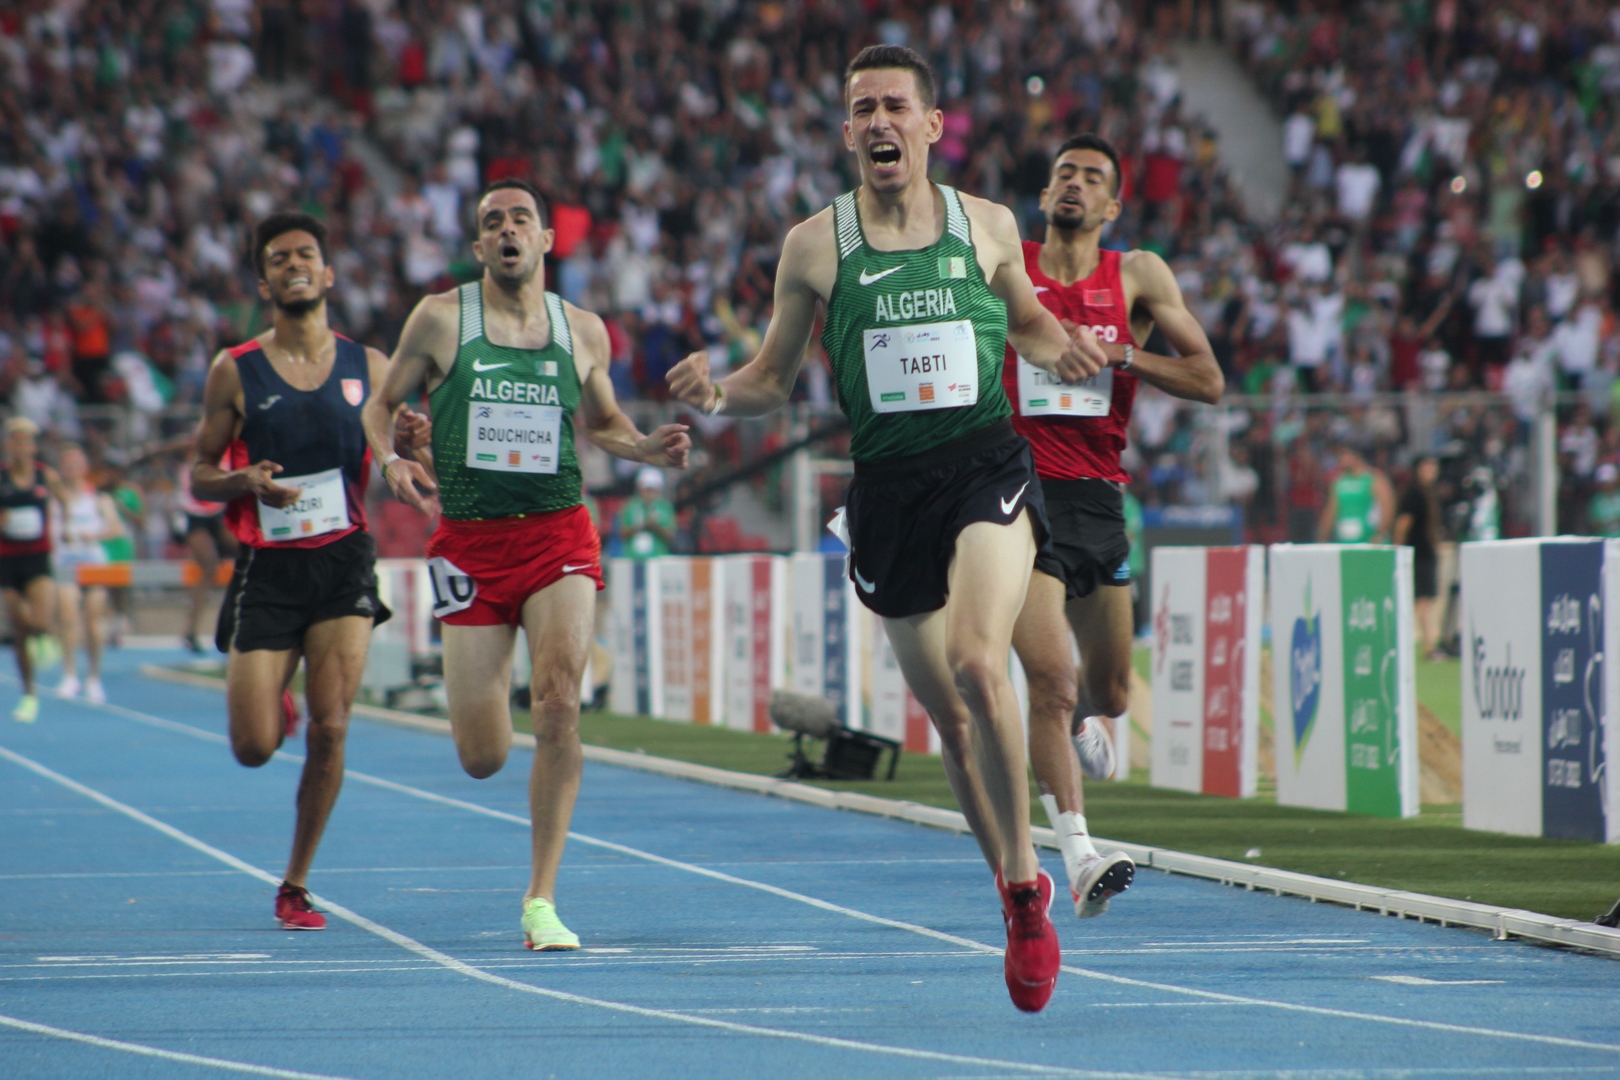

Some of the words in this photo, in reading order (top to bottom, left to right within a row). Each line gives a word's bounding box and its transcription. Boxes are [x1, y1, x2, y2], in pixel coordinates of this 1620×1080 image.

[875, 287, 957, 323] ALGERIA
[900, 354, 946, 375] TABTI
[469, 377, 560, 406] ALGERIA
[478, 426, 552, 444] BOUCHICHA
